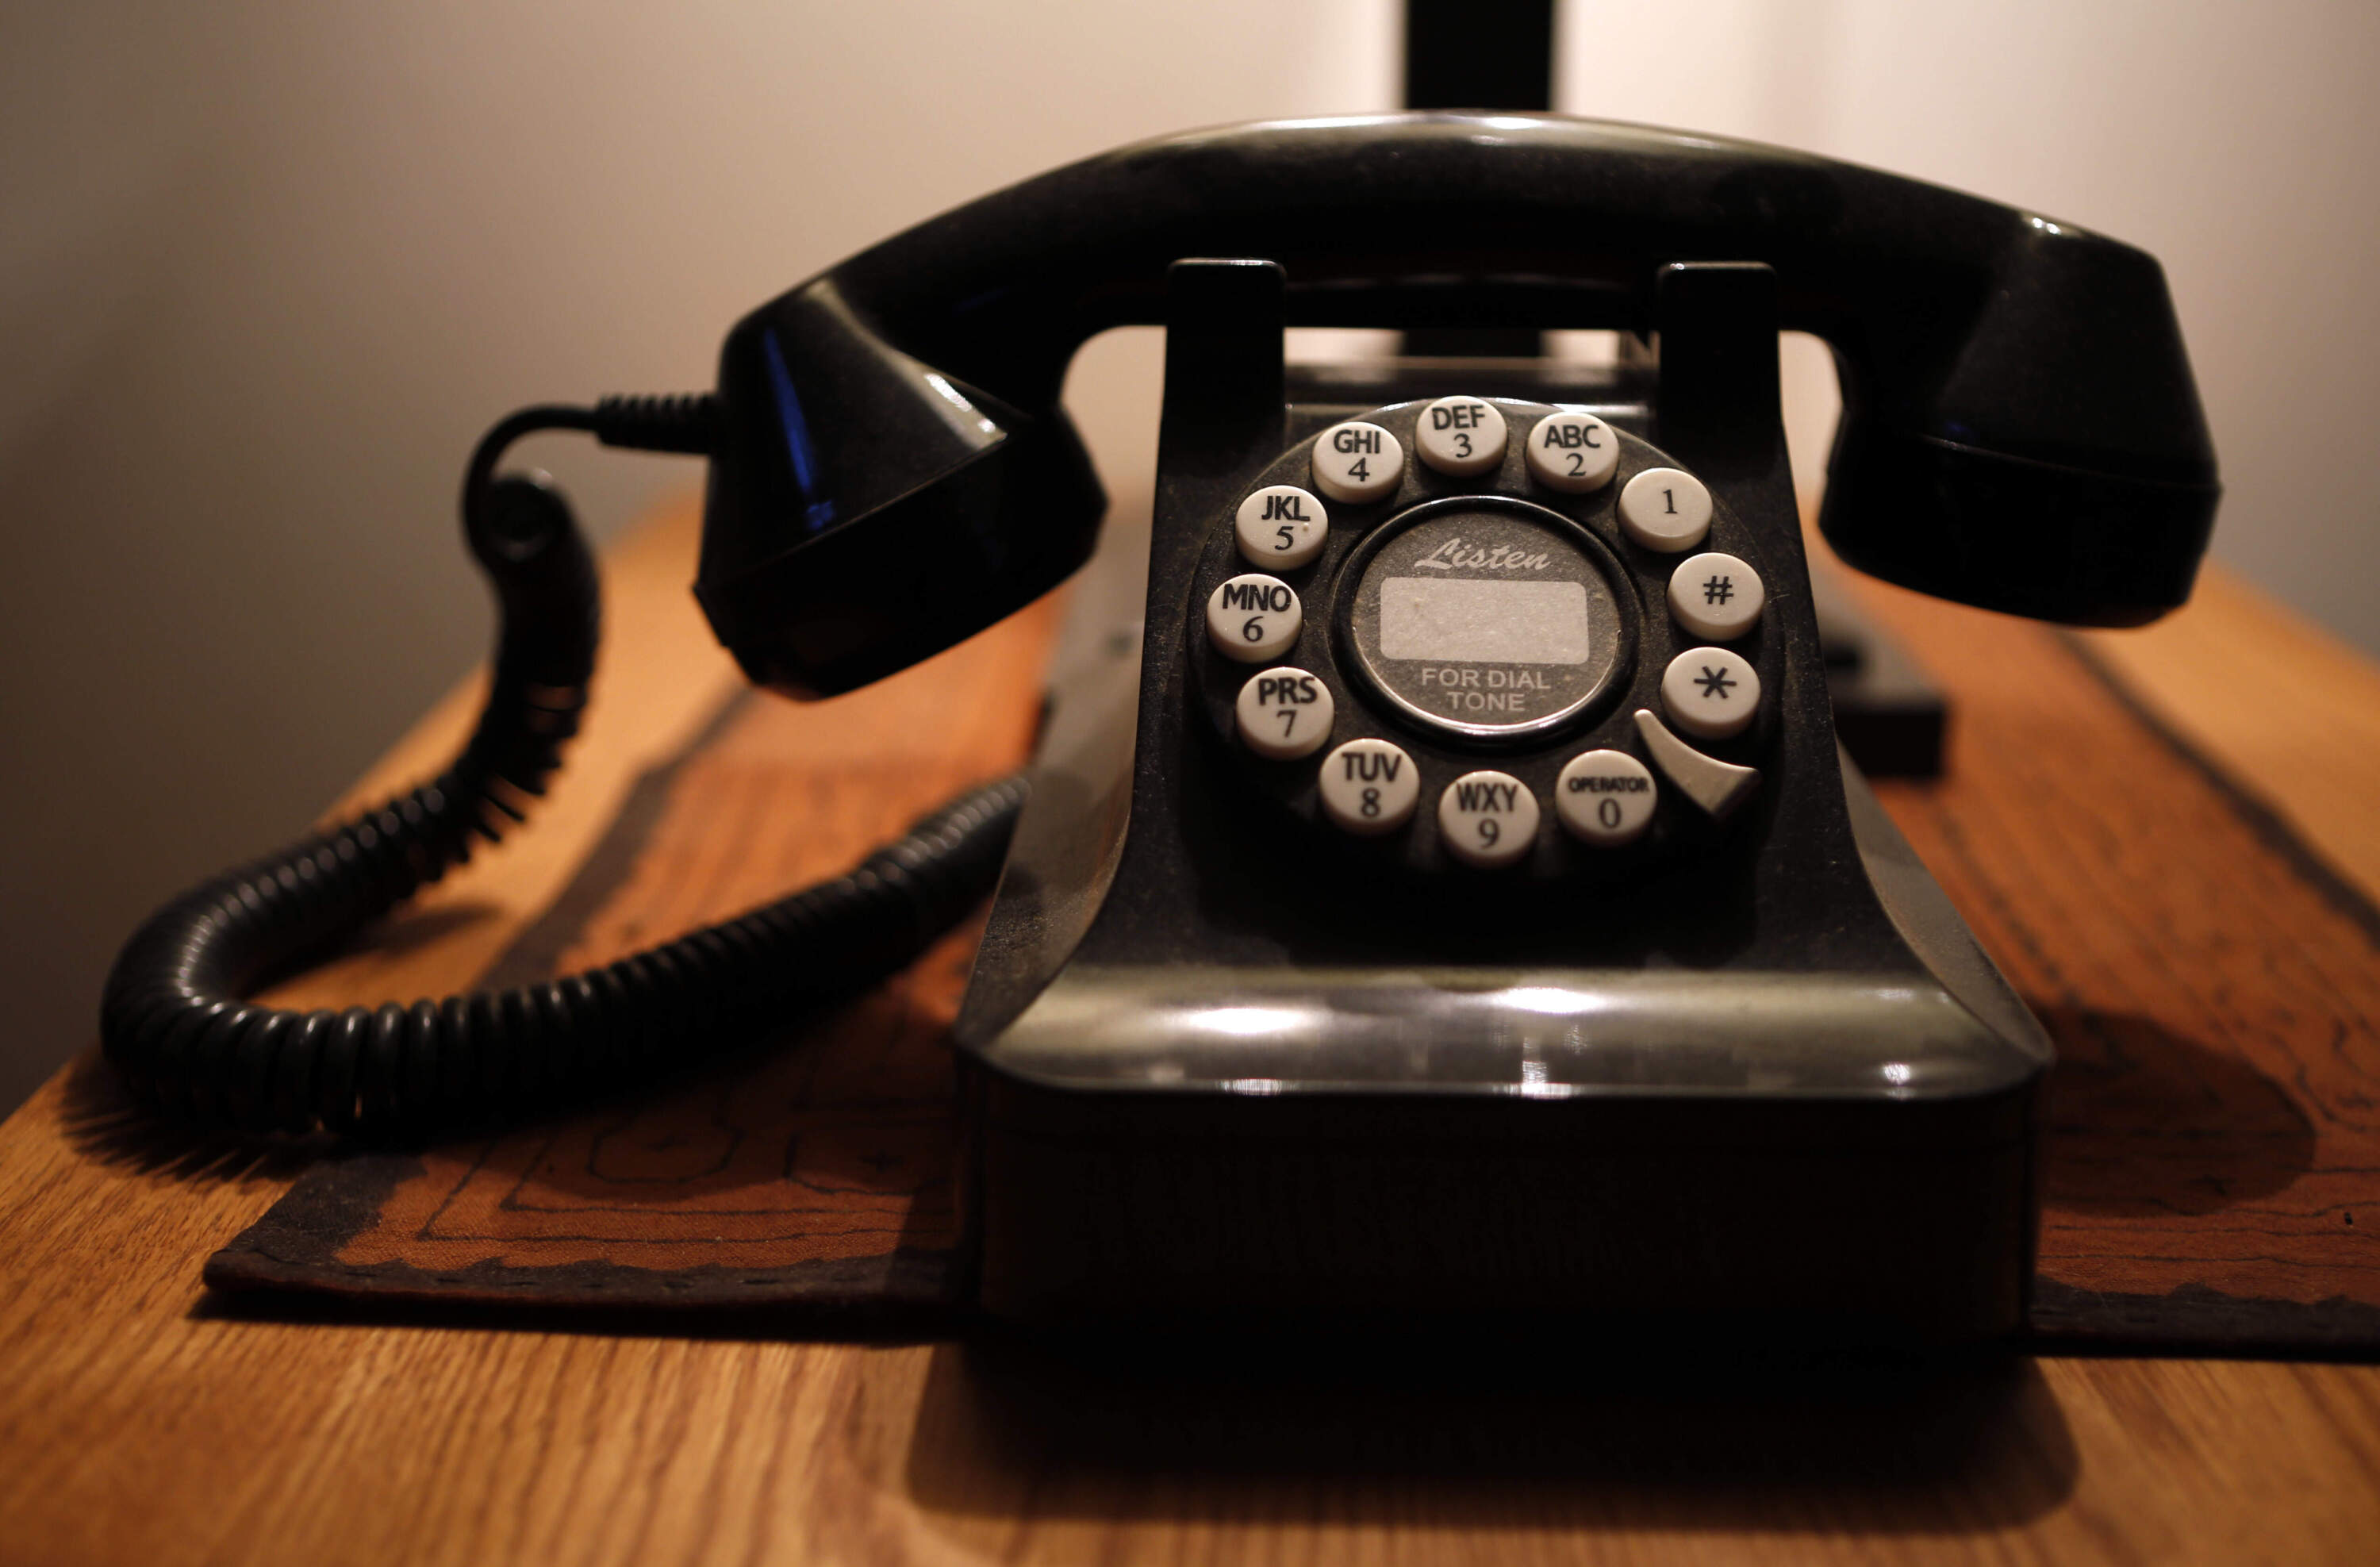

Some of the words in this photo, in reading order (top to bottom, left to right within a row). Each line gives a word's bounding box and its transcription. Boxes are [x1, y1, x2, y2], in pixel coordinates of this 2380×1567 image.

[1431, 404, 1485, 431] DEF
[1333, 429, 1381, 455] GHI
[1453, 433, 1473, 458] 3
[1544, 424, 1601, 449] ABC
[1348, 457, 1370, 482] 4
[1565, 453, 1587, 477] 2
[1261, 495, 1311, 521] JKL
[1662, 489, 1679, 514] 1
[1274, 525, 1295, 551] 5
[1414, 537, 1551, 570] Listen
[1222, 583, 1292, 612] MNO
[1702, 575, 1735, 605] #
[1242, 616, 1265, 642] 6
[1257, 676, 1319, 706] PRS
[1420, 667, 1480, 687] FOR
[1487, 669, 1552, 689] DIAL
[1446, 691, 1526, 712] TONE
[1276, 709, 1298, 739] 7
[1340, 751, 1403, 783] TUV
[1456, 782, 1520, 814] WXY
[1568, 776, 1651, 794] OPERATOR
[1361, 787, 1382, 818] 8
[1598, 797, 1622, 829] 0
[1477, 818, 1501, 849] 9
